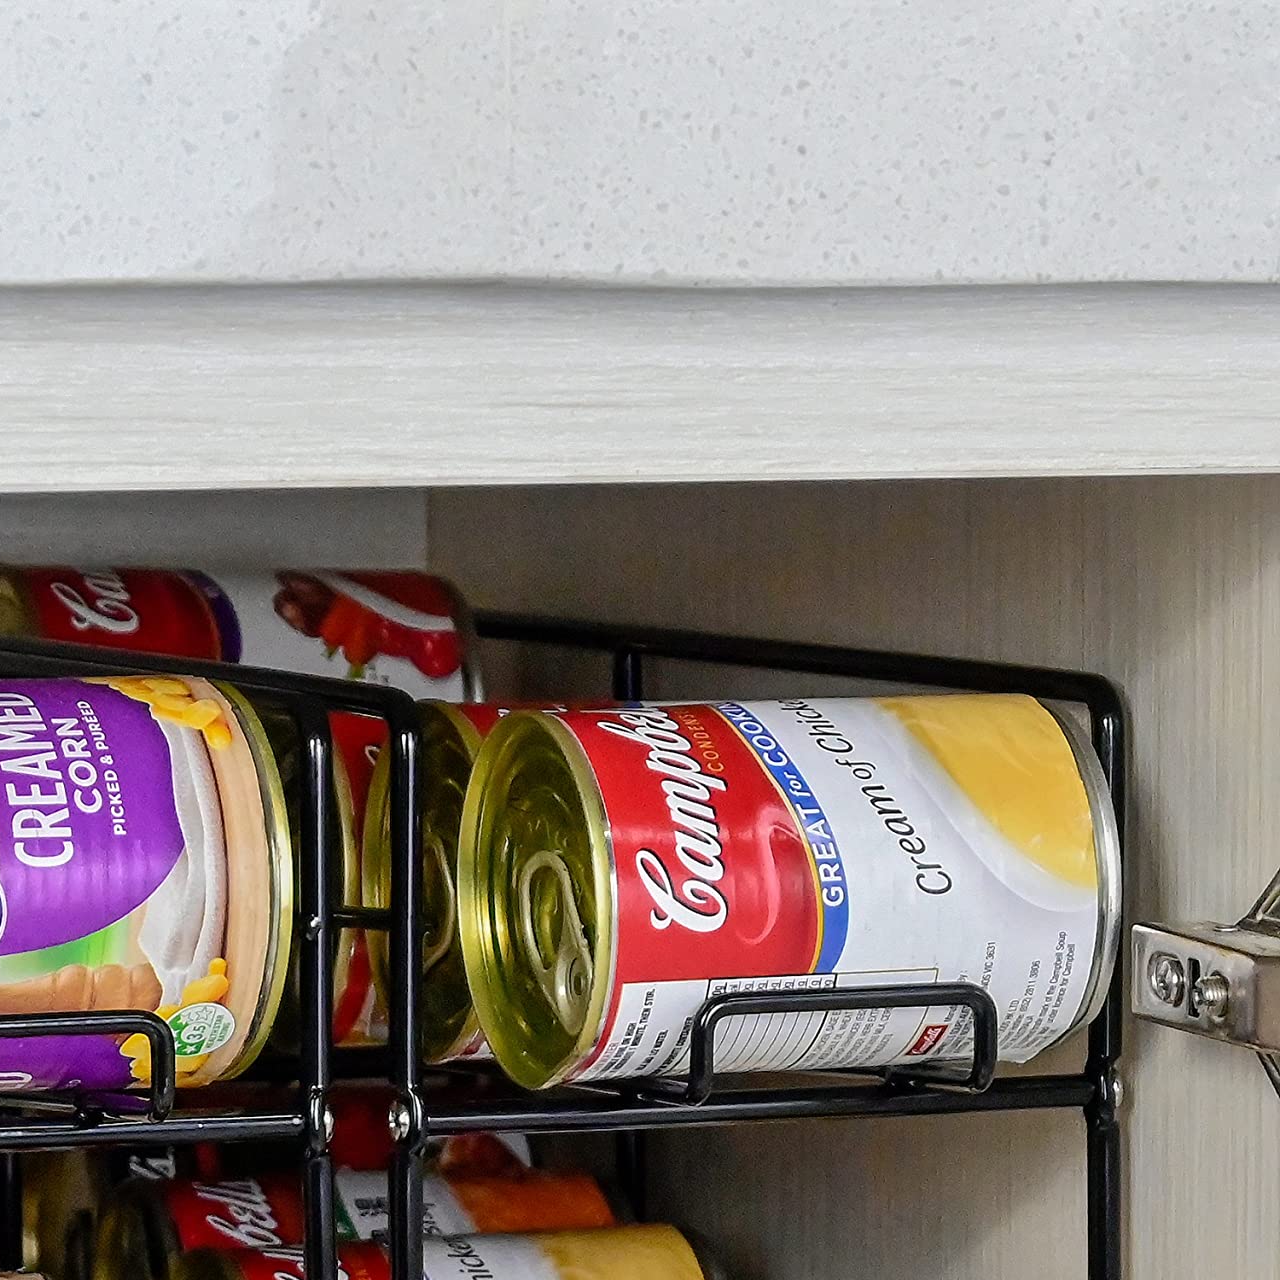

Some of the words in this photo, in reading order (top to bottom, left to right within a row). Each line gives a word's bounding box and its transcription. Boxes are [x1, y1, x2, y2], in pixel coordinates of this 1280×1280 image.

[50, 717, 103, 814] CORN
[99, 754, 114, 765] &
[834, 757, 876, 780] of
[783, 771, 811, 797] for
[103, 769, 127, 836] PICKED
[795, 803, 844, 908] GREAT
[860, 784, 953, 896] Cream
[1056, 932, 1068, 952] Soup
[1050, 952, 1065, 984] Campbell
[1062, 943, 1077, 977] Campbell
[186, 1023, 207, 1041] 3.5
